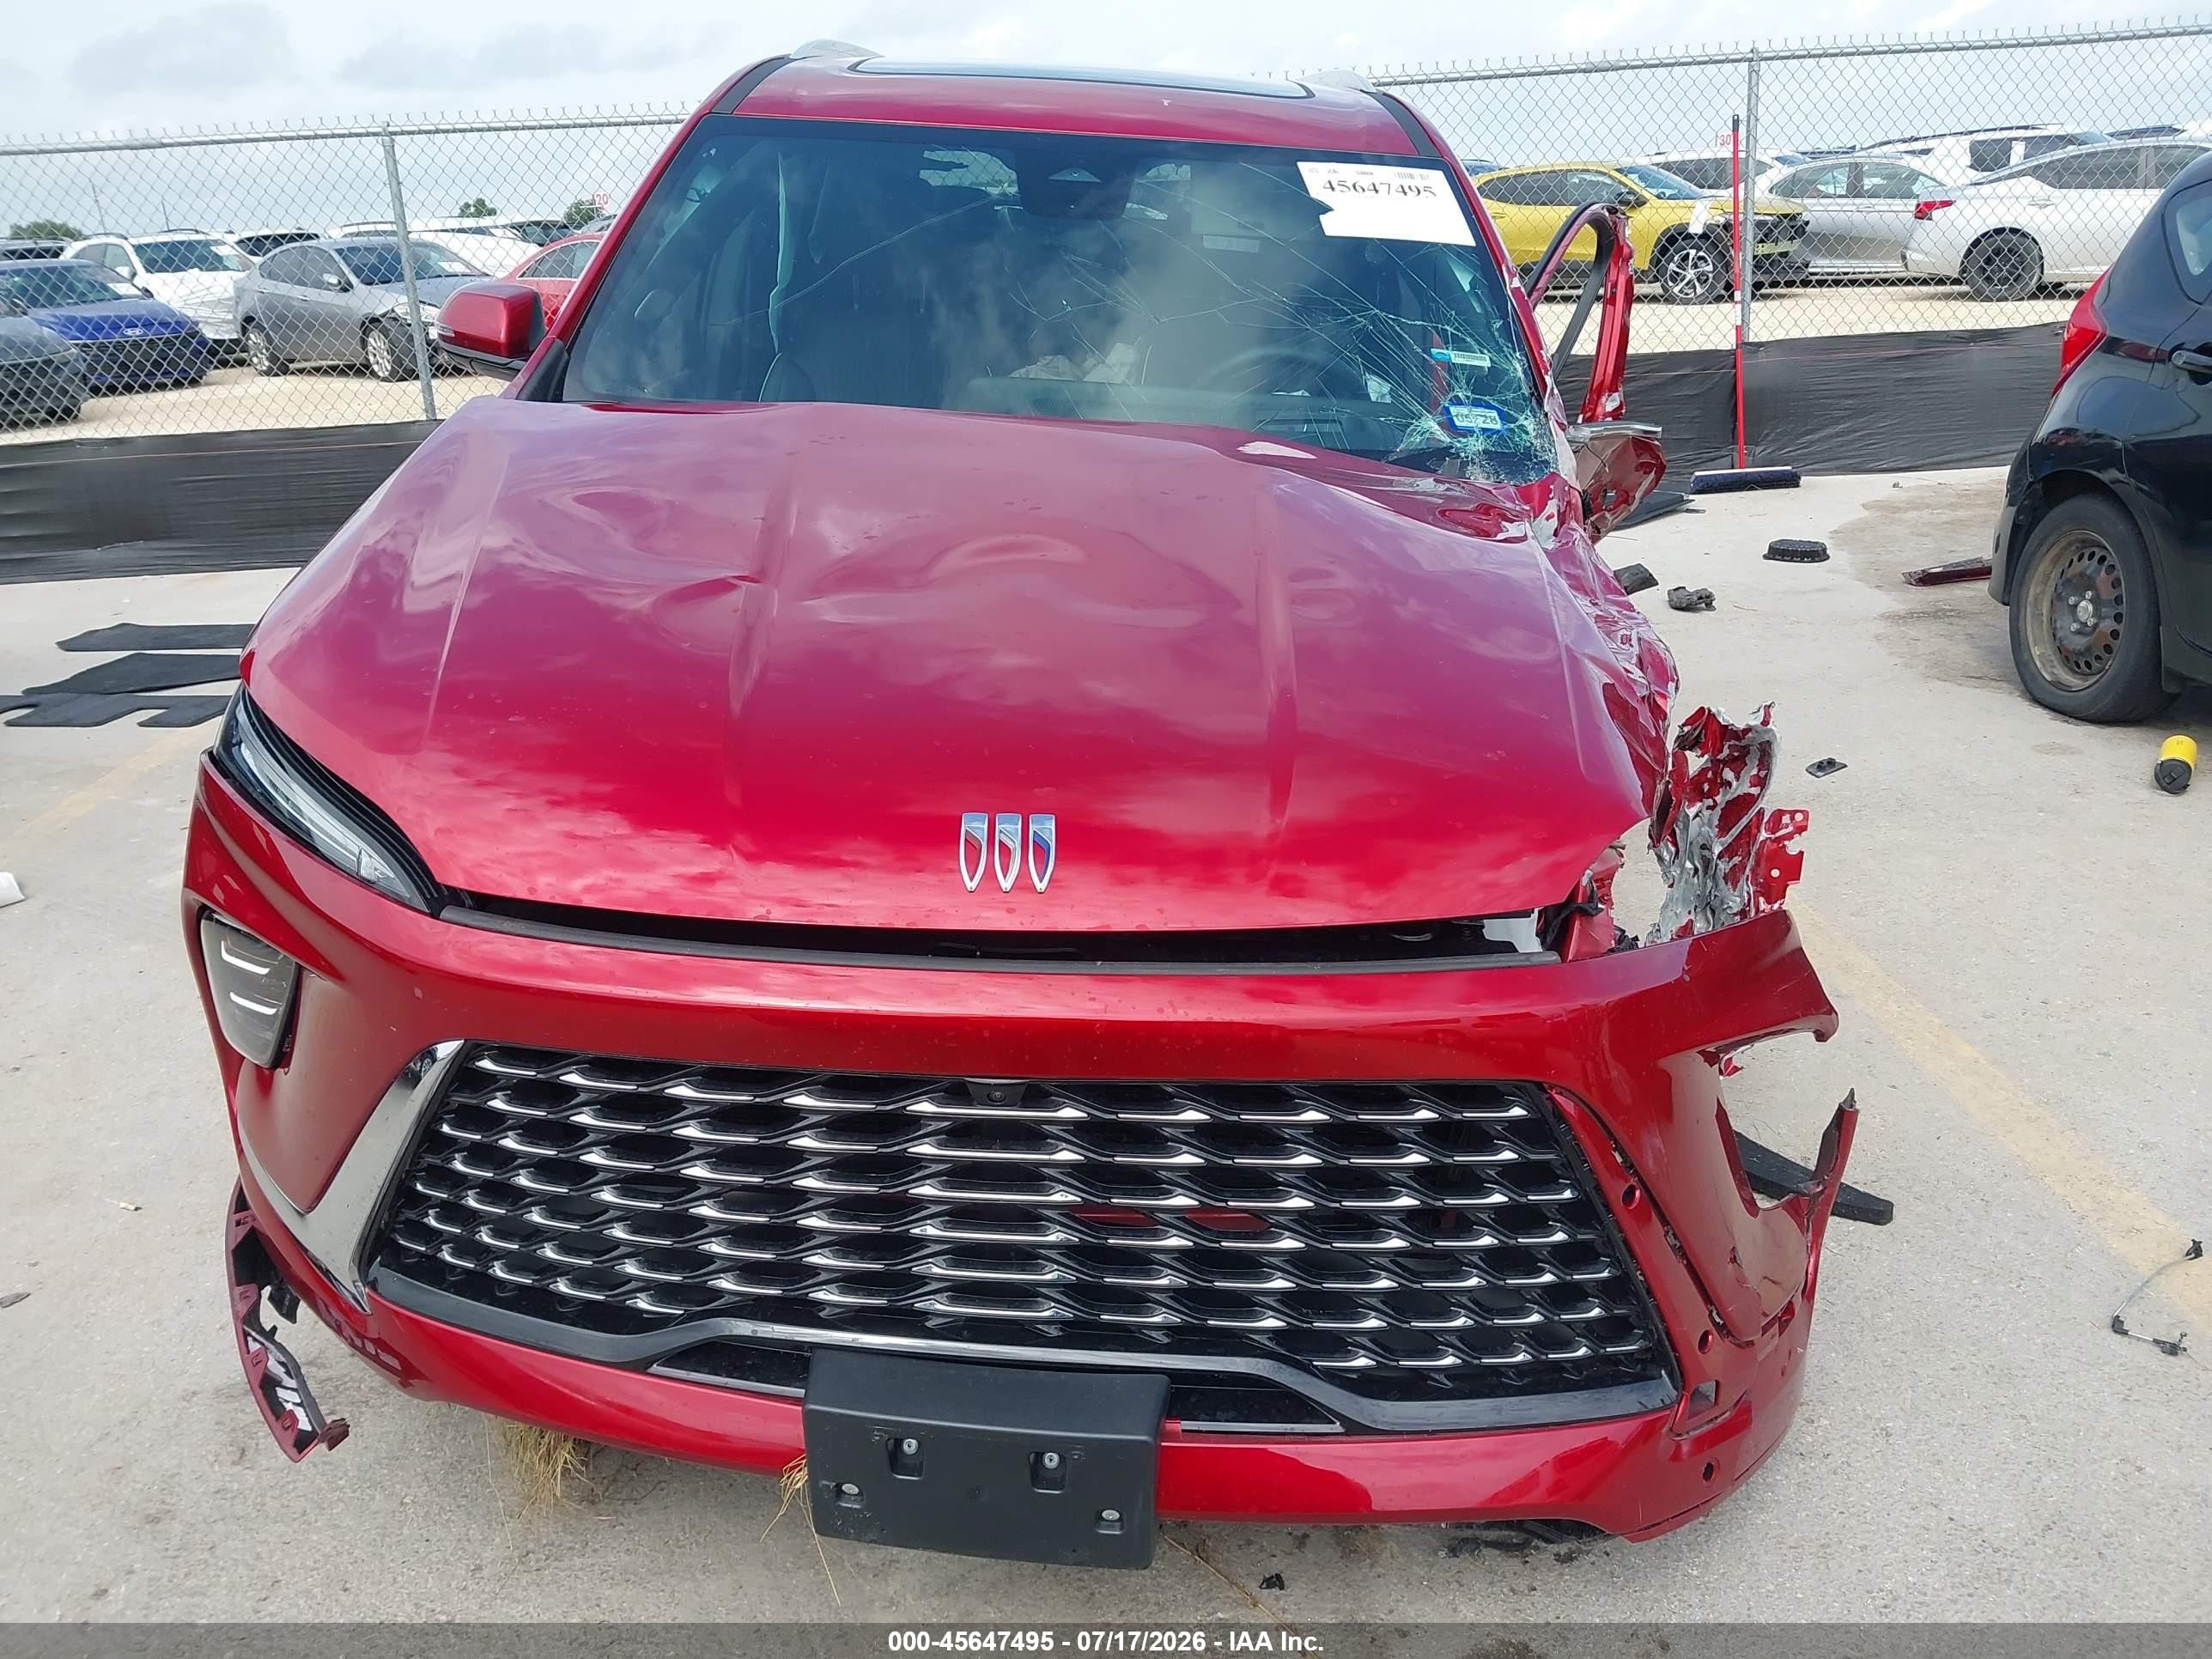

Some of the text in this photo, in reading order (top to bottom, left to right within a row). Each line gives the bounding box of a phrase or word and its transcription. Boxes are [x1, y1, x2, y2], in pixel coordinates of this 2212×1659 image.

[1718, 133, 1732, 146] 30
[1322, 179, 1437, 198] 45647495
[595, 193, 609, 205] 20
